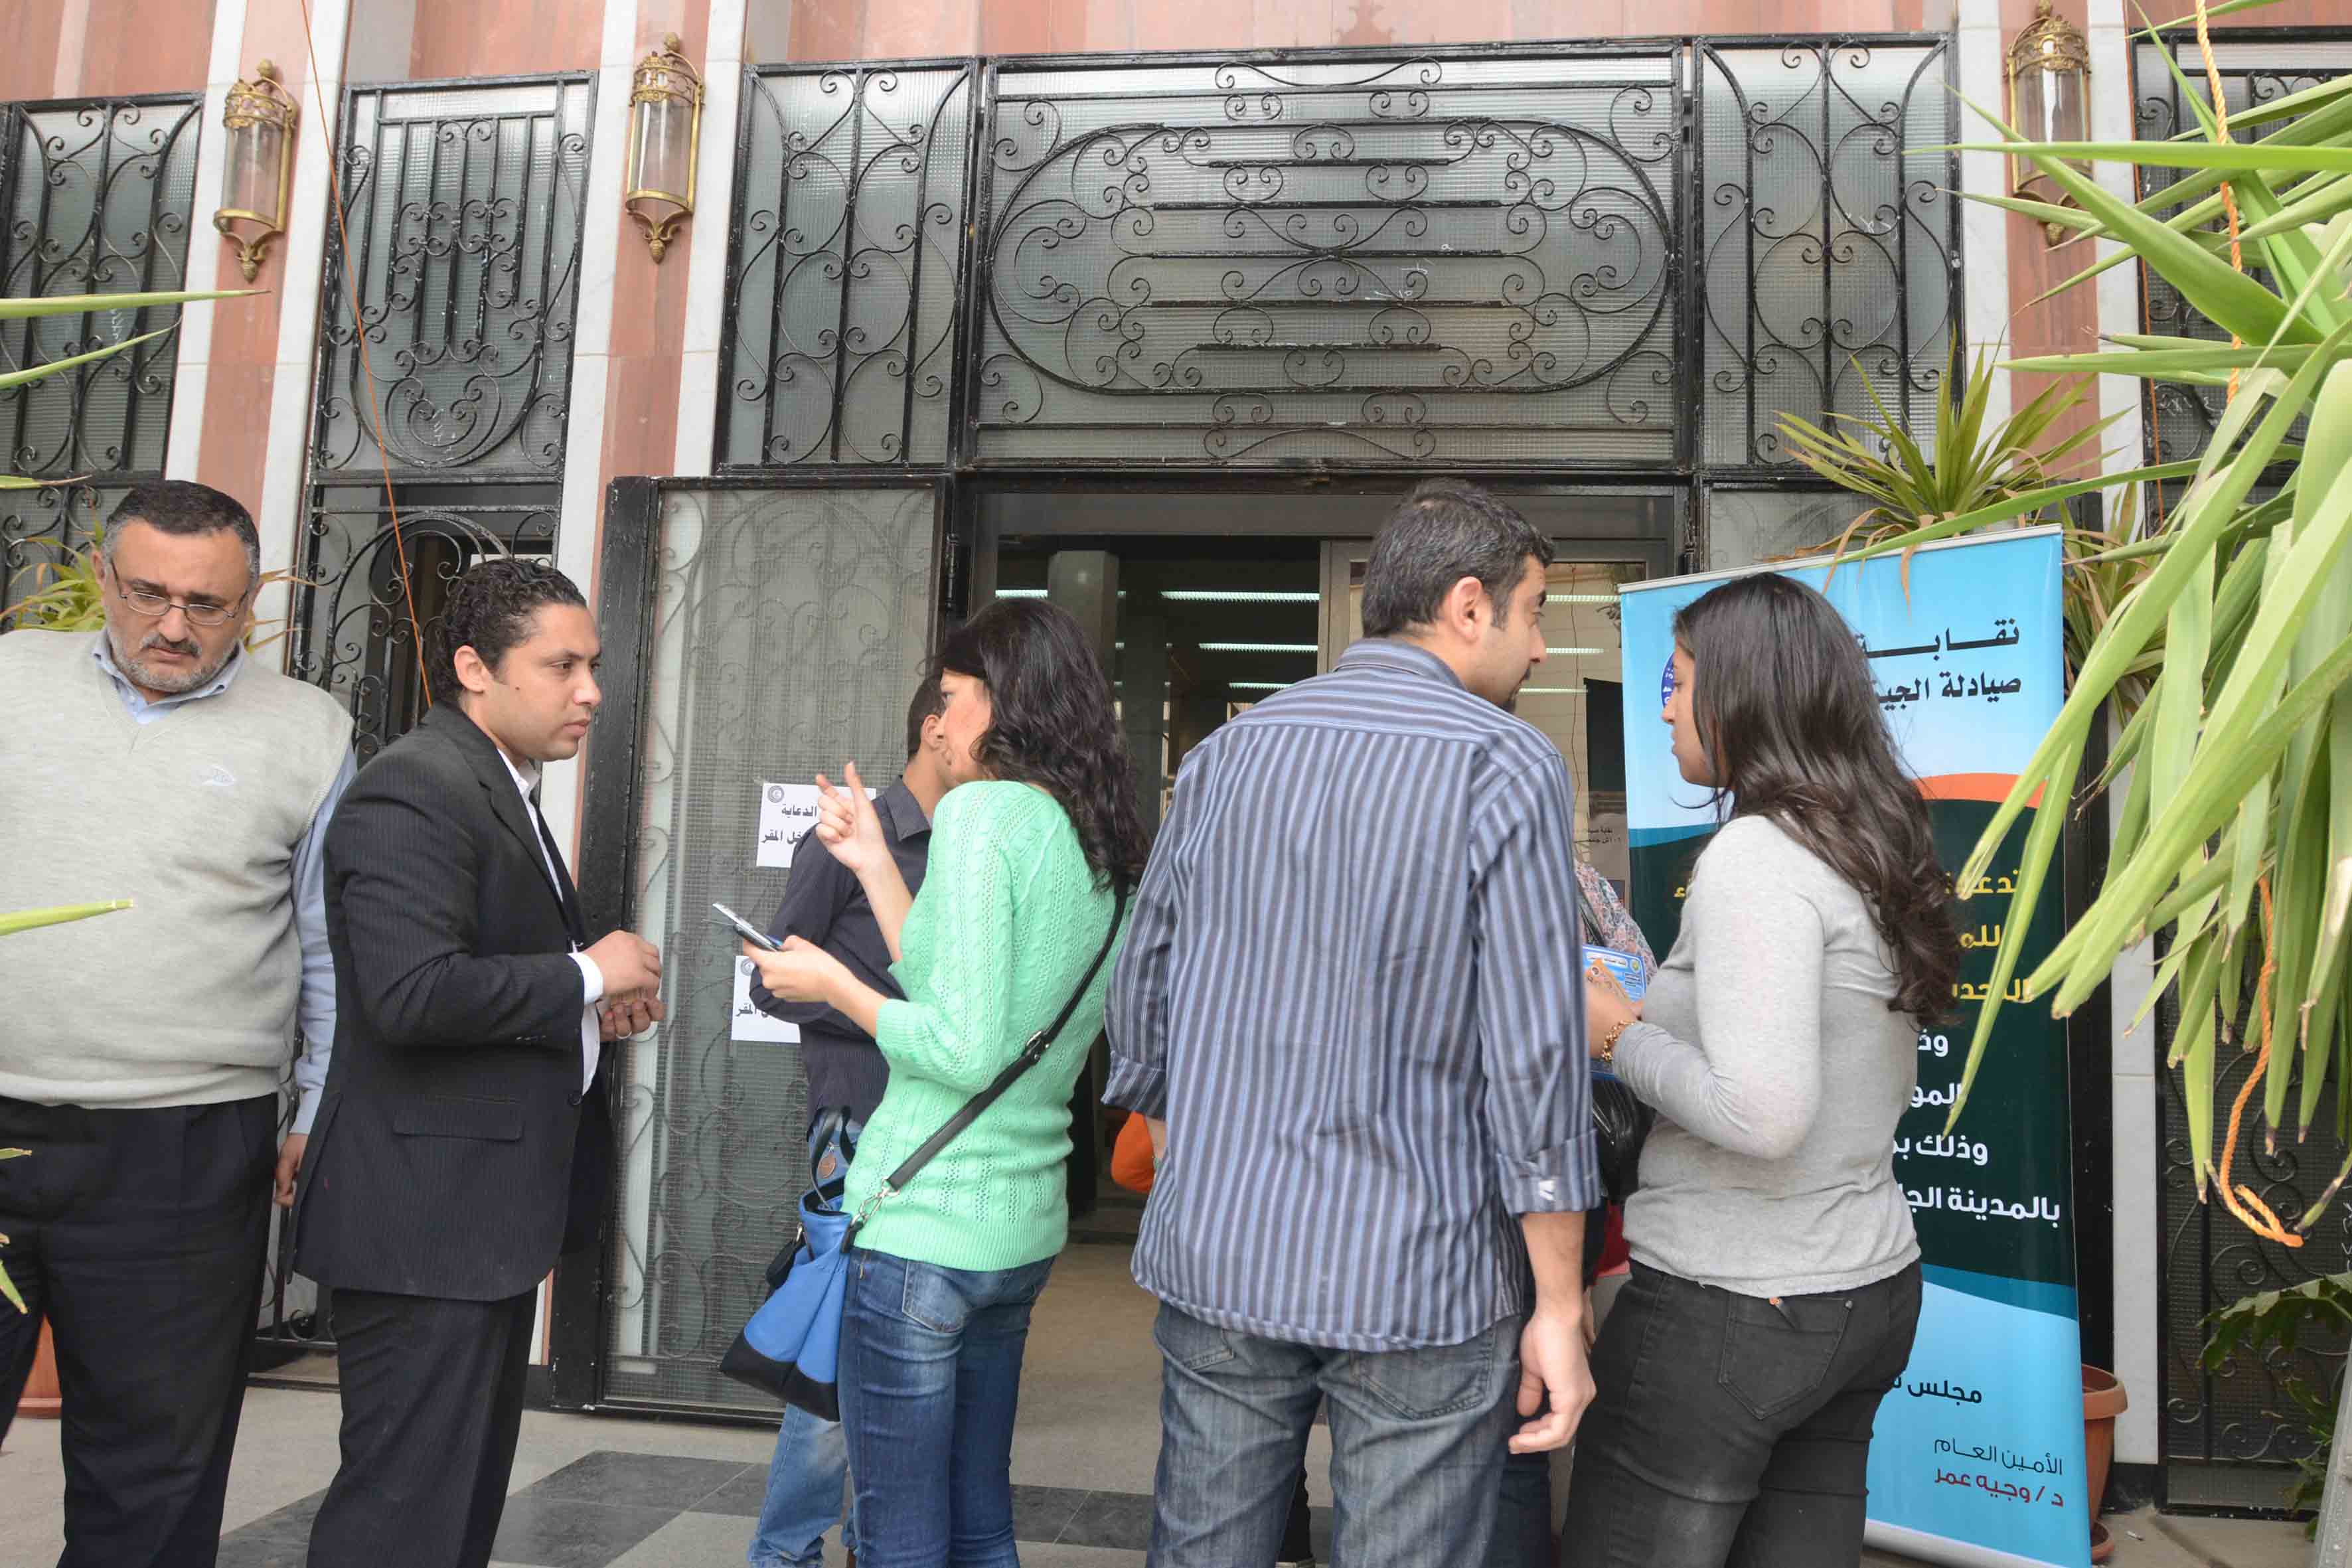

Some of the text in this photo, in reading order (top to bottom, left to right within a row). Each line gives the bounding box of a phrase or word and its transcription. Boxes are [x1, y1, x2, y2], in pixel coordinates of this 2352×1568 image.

[1872, 670, 2021, 710] صيادلة الجي
[781, 803, 817, 818] الدعاية
[761, 829, 783, 843] المقر
[1915, 1135, 1988, 1166] وذلك
[1948, 1187, 2060, 1228] بالمدينة
[1907, 1379, 1982, 1405] مجلس
[1934, 1437, 2063, 1475] الأمين العام
[1934, 1468, 1972, 1487] عمر
